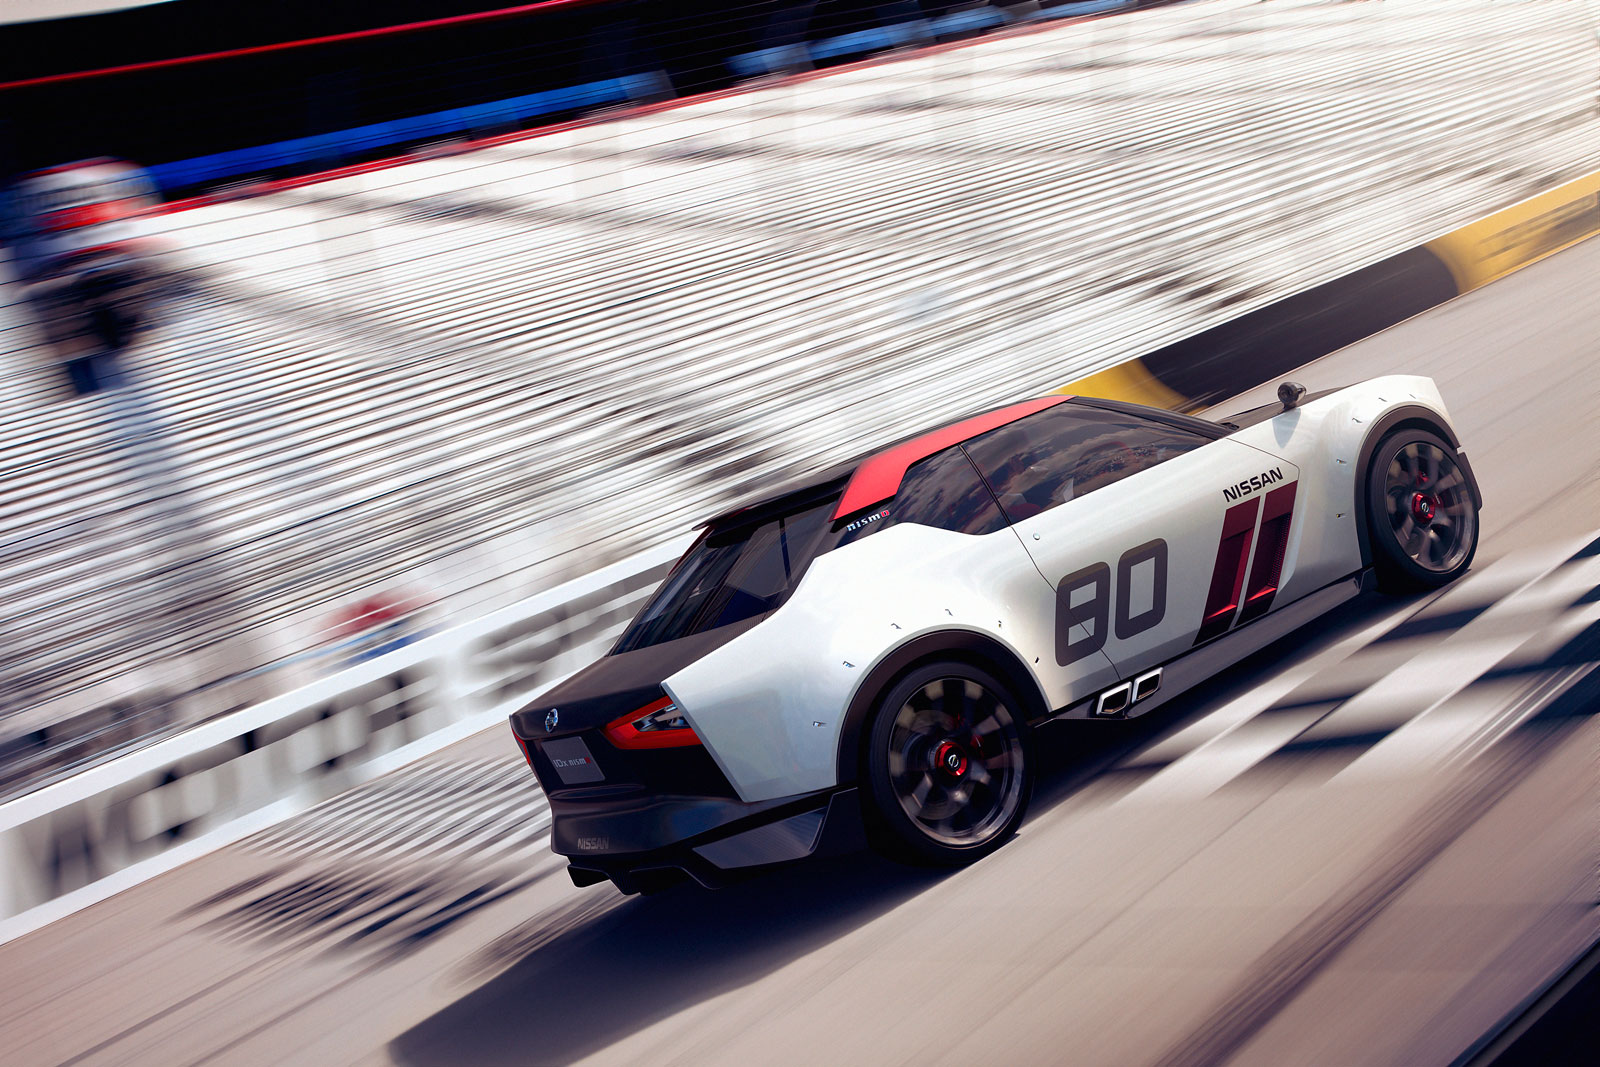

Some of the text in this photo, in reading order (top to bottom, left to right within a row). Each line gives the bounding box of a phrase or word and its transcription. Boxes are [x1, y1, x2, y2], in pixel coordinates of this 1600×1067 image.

[1222, 466, 1284, 503] NISSAN
[846, 509, 890, 532] nismo
[1055, 537, 1168, 667] 80
[577, 837, 609, 850] NISSAN
